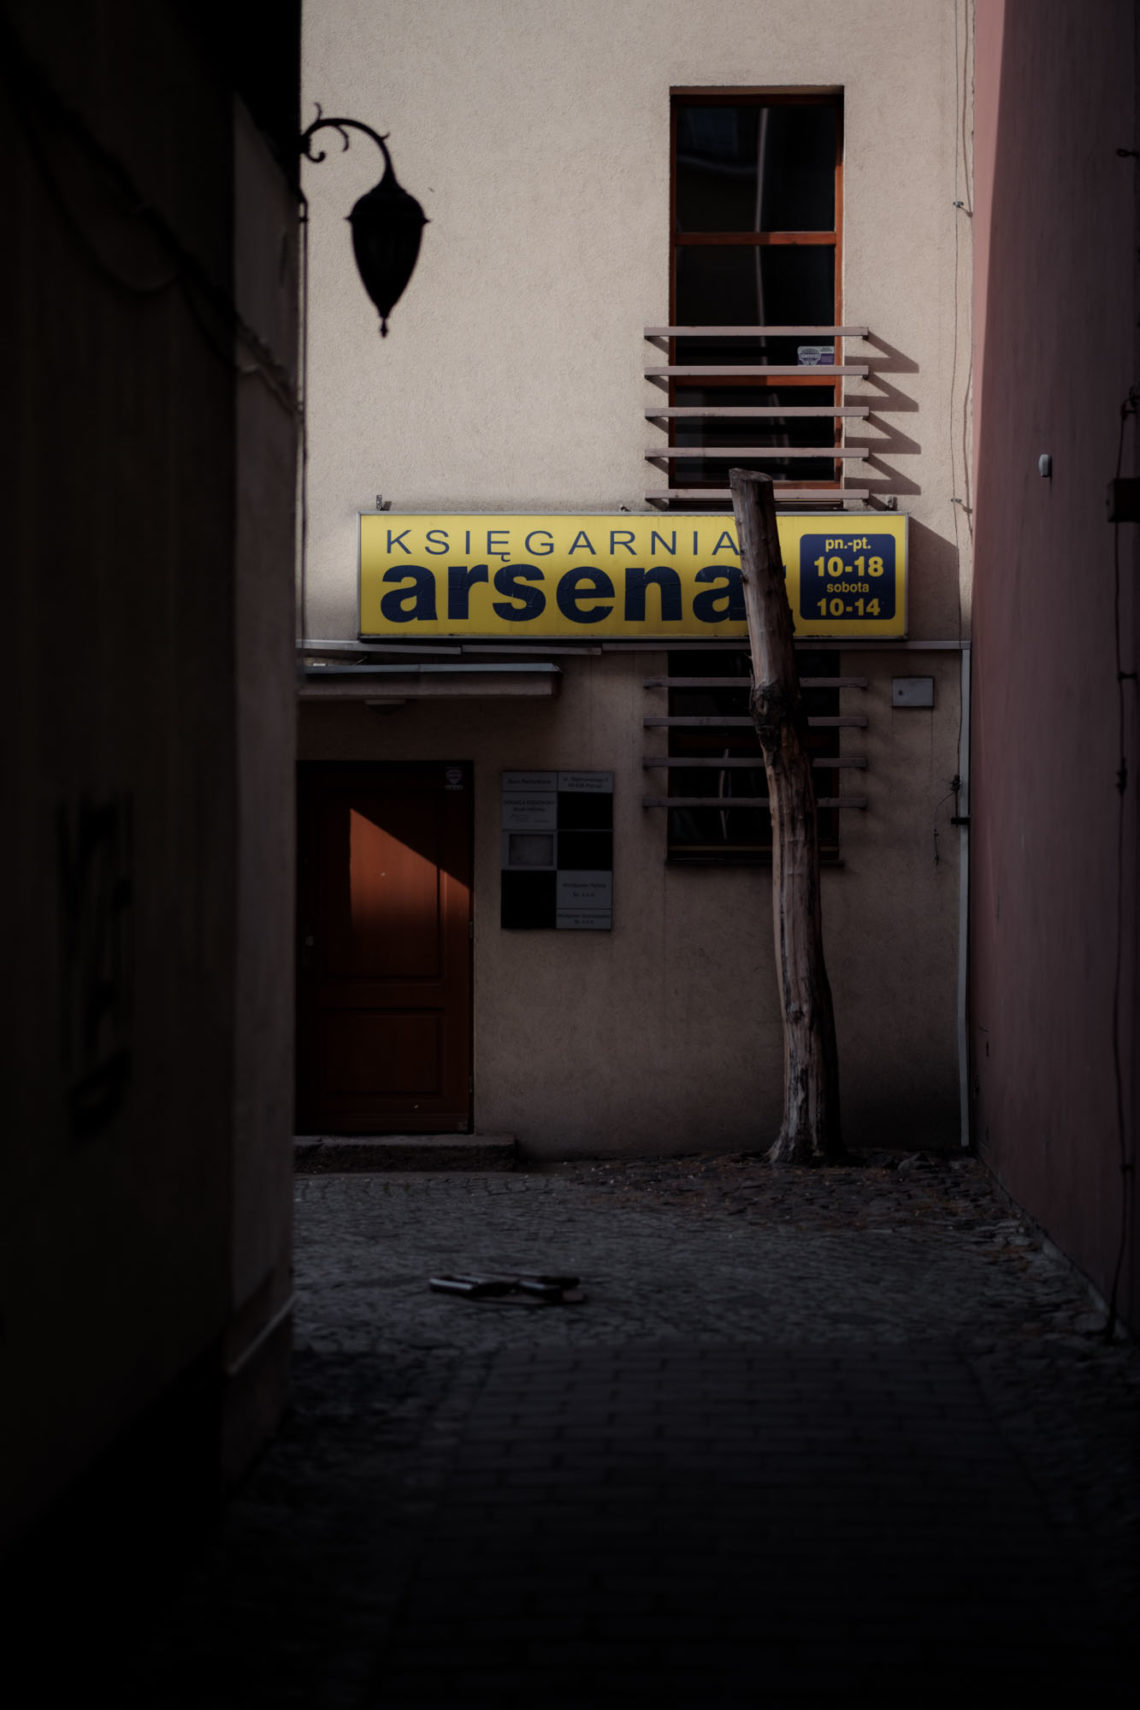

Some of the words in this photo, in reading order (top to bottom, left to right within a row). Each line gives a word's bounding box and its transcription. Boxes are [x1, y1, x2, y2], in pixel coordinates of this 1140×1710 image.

[386, 529, 743, 562] KSIĘGARNIA
[825, 537, 872, 553] pn.-pt.
[813, 555, 884, 578] 10-18
[380, 564, 786, 624] arsena
[826, 581, 870, 593] sobota
[816, 597, 881, 617] 10-14
